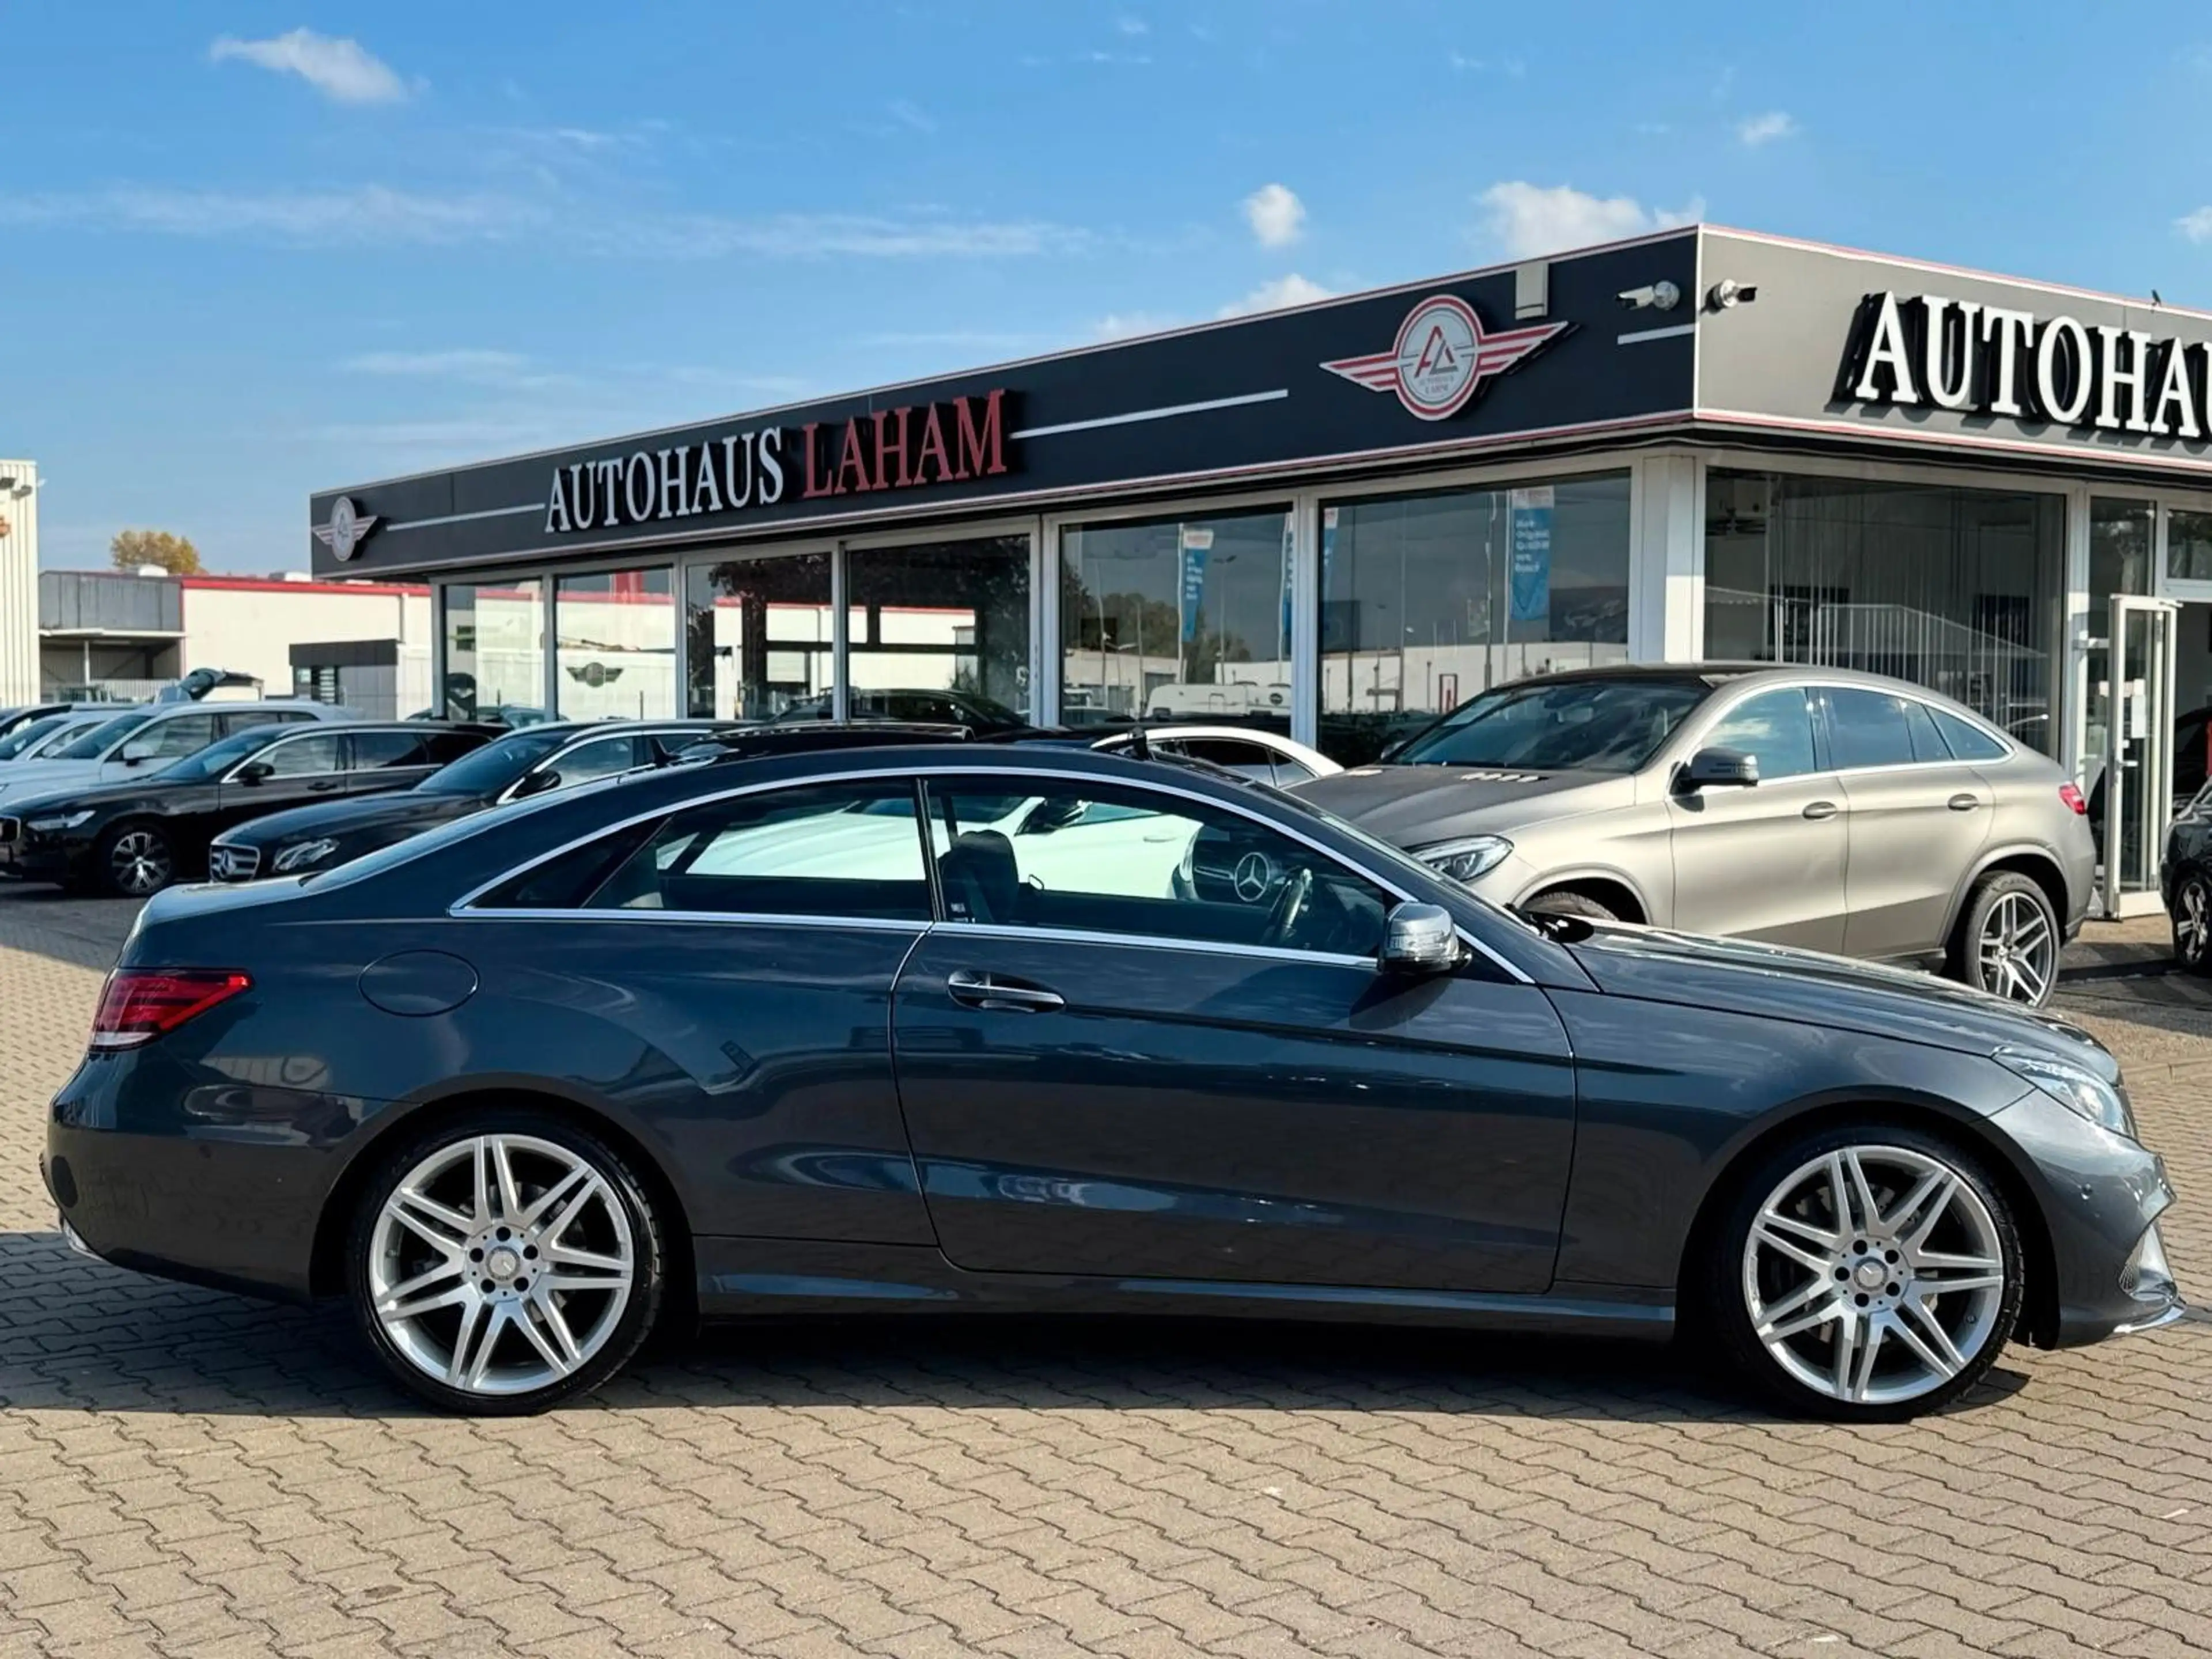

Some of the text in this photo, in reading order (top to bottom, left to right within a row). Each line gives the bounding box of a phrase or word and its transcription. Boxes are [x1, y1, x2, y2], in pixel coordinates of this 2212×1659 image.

[1855, 290, 2212, 438] AUTOHA
[544, 388, 1007, 533] AUTOHAUS LAHAM
